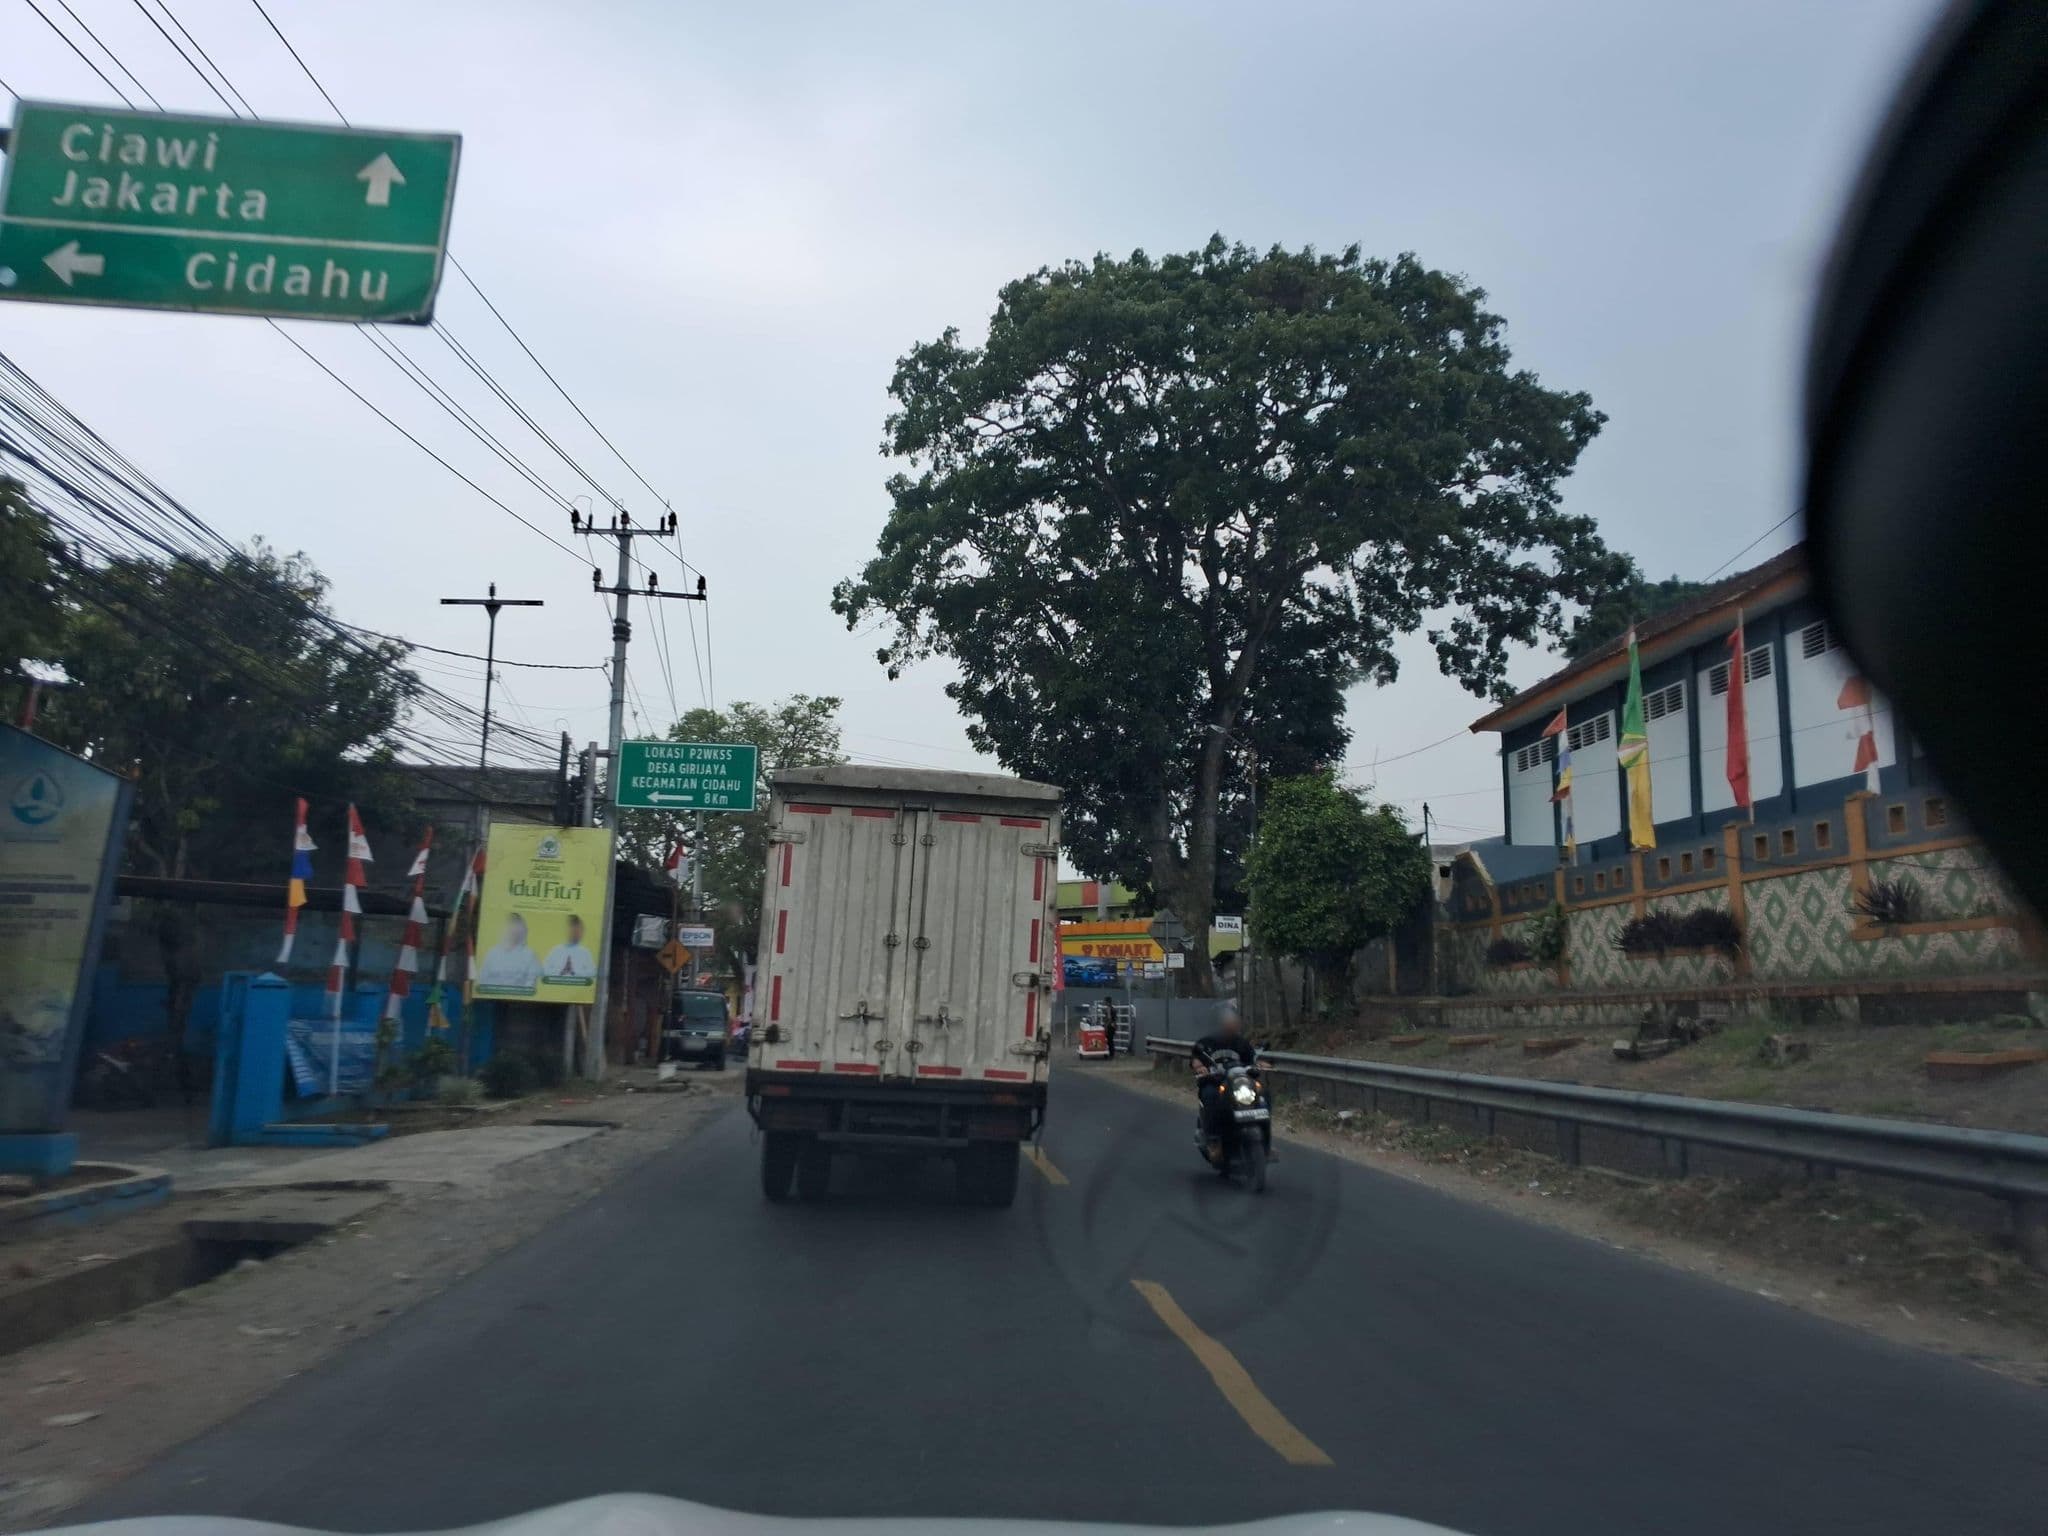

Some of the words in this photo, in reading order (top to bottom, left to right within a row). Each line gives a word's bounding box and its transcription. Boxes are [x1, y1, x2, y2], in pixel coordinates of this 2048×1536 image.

[61, 123, 219, 172] Ciawi
[53, 170, 268, 222] Jakarta
[185, 252, 389, 301] Cidahu
[645, 747, 685, 759] LOKASI
[689, 748, 733, 760] P2WKSS
[648, 761, 676, 774] DESA
[679, 763, 727, 776] GIRIJAYA
[632, 776, 698, 789] KECAMATAN
[702, 779, 741, 791] CIDAHU
